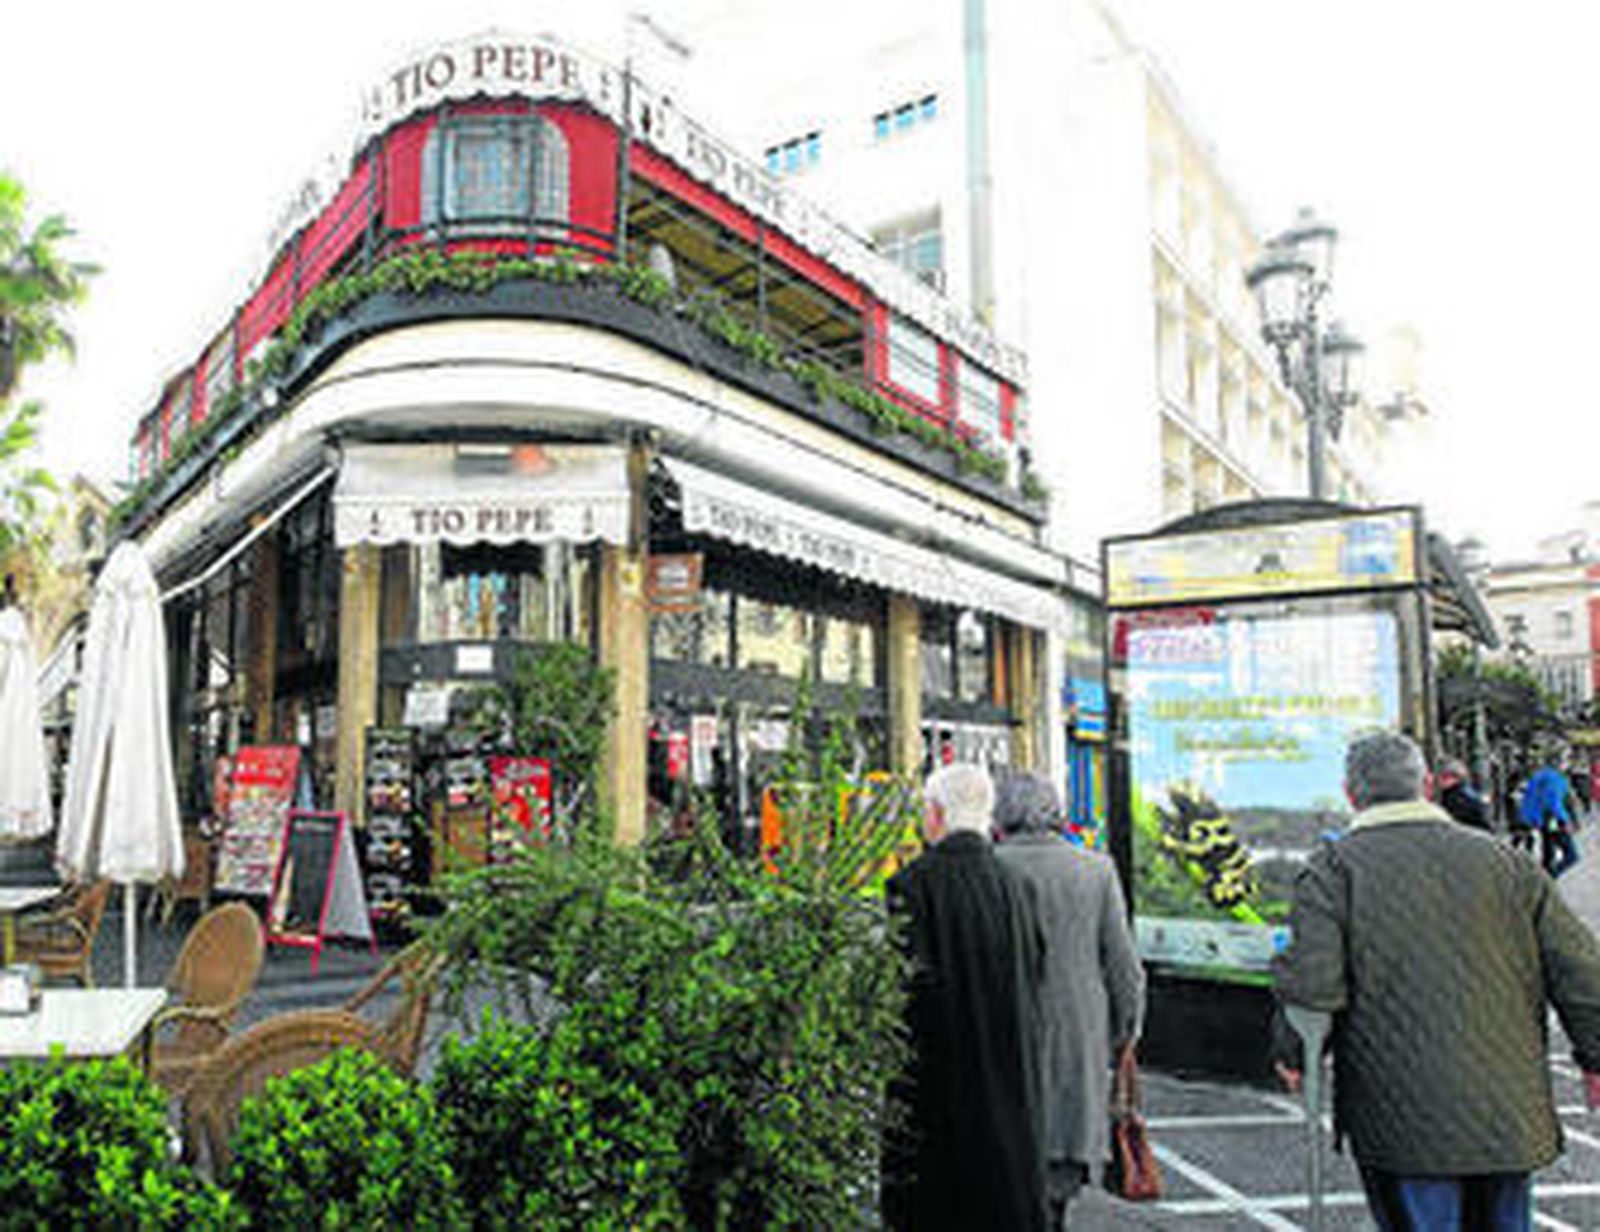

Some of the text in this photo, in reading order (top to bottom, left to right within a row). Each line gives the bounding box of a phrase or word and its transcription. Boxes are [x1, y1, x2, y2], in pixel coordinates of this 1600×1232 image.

[389, 46, 578, 105] TIO PEPE
[411, 508, 552, 534] TIO PEPE
